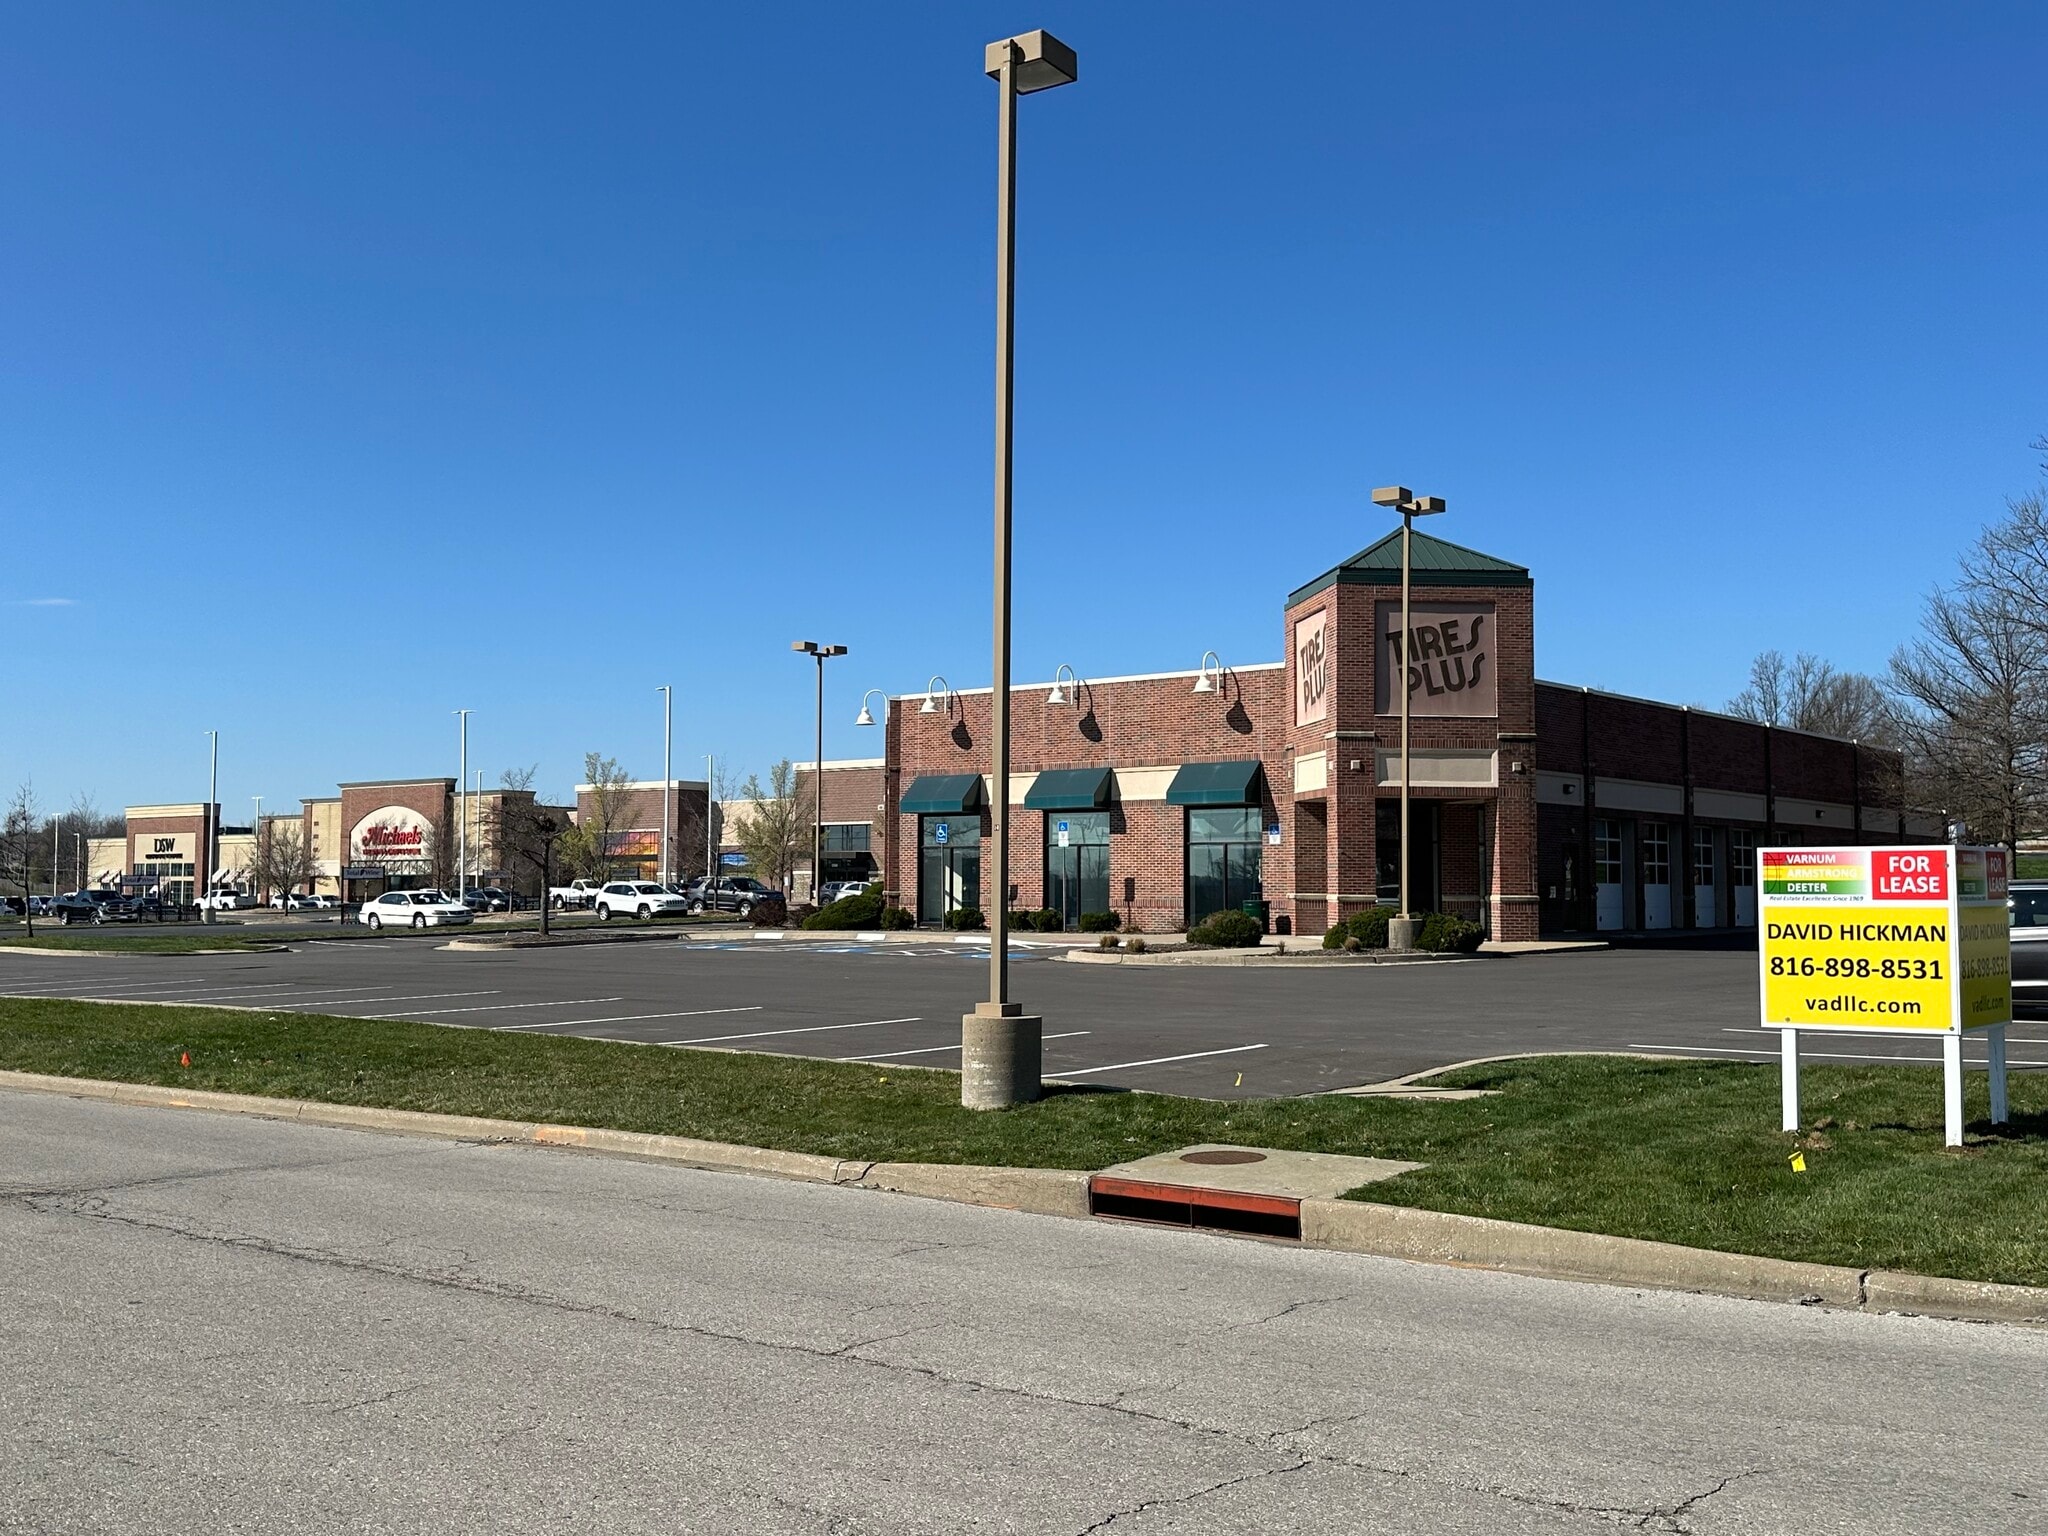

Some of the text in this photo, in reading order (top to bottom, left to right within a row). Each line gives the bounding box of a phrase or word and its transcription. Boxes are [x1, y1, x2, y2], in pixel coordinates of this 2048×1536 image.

[1385, 615, 1484, 665] TIRES
[1300, 623, 1326, 679] TIRES
[1303, 658, 1326, 713] PLUS
[1398, 652, 1486, 700] PLUS
[154, 838, 176, 853] DSW
[361, 825, 423, 847] Michaels
[1786, 854, 1836, 864] VARNUM
[1888, 856, 1930, 873] FOR
[1990, 857, 2003, 873] FOR
[1787, 868, 1857, 878] ARMSTRONG
[1787, 882, 1828, 892] DEETER
[1879, 876, 1941, 894] LEASE
[1989, 876, 2006, 893] LEASE
[1768, 923, 1946, 942] DAVID HICKMAN
[1960, 923, 2009, 942] DAVID HICKMAN
[1770, 956, 1943, 980] 816-898-8531
[1961, 956, 2009, 980] 816-898-8531
[1805, 995, 1921, 1014] vadllc.com
